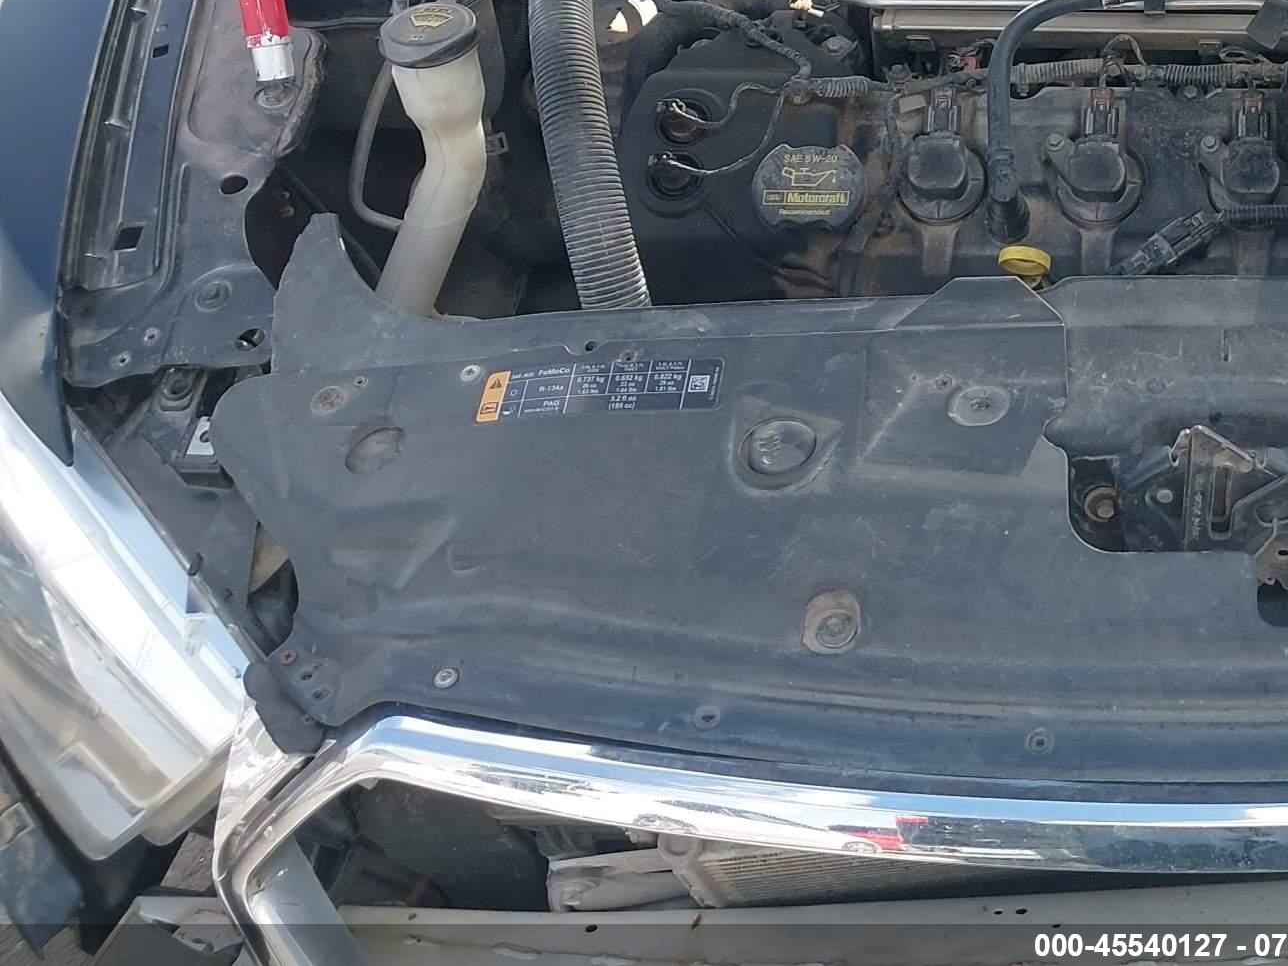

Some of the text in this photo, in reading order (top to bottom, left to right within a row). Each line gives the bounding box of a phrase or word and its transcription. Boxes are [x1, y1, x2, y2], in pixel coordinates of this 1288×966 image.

[783, 153, 804, 163] SAE
[787, 192, 847, 203] Motorcraft
[779, 208, 831, 216] Recommended
[538, 367, 571, 376] FoMoCo
[673, 373, 683, 381] kg
[538, 384, 564, 392] R-134a
